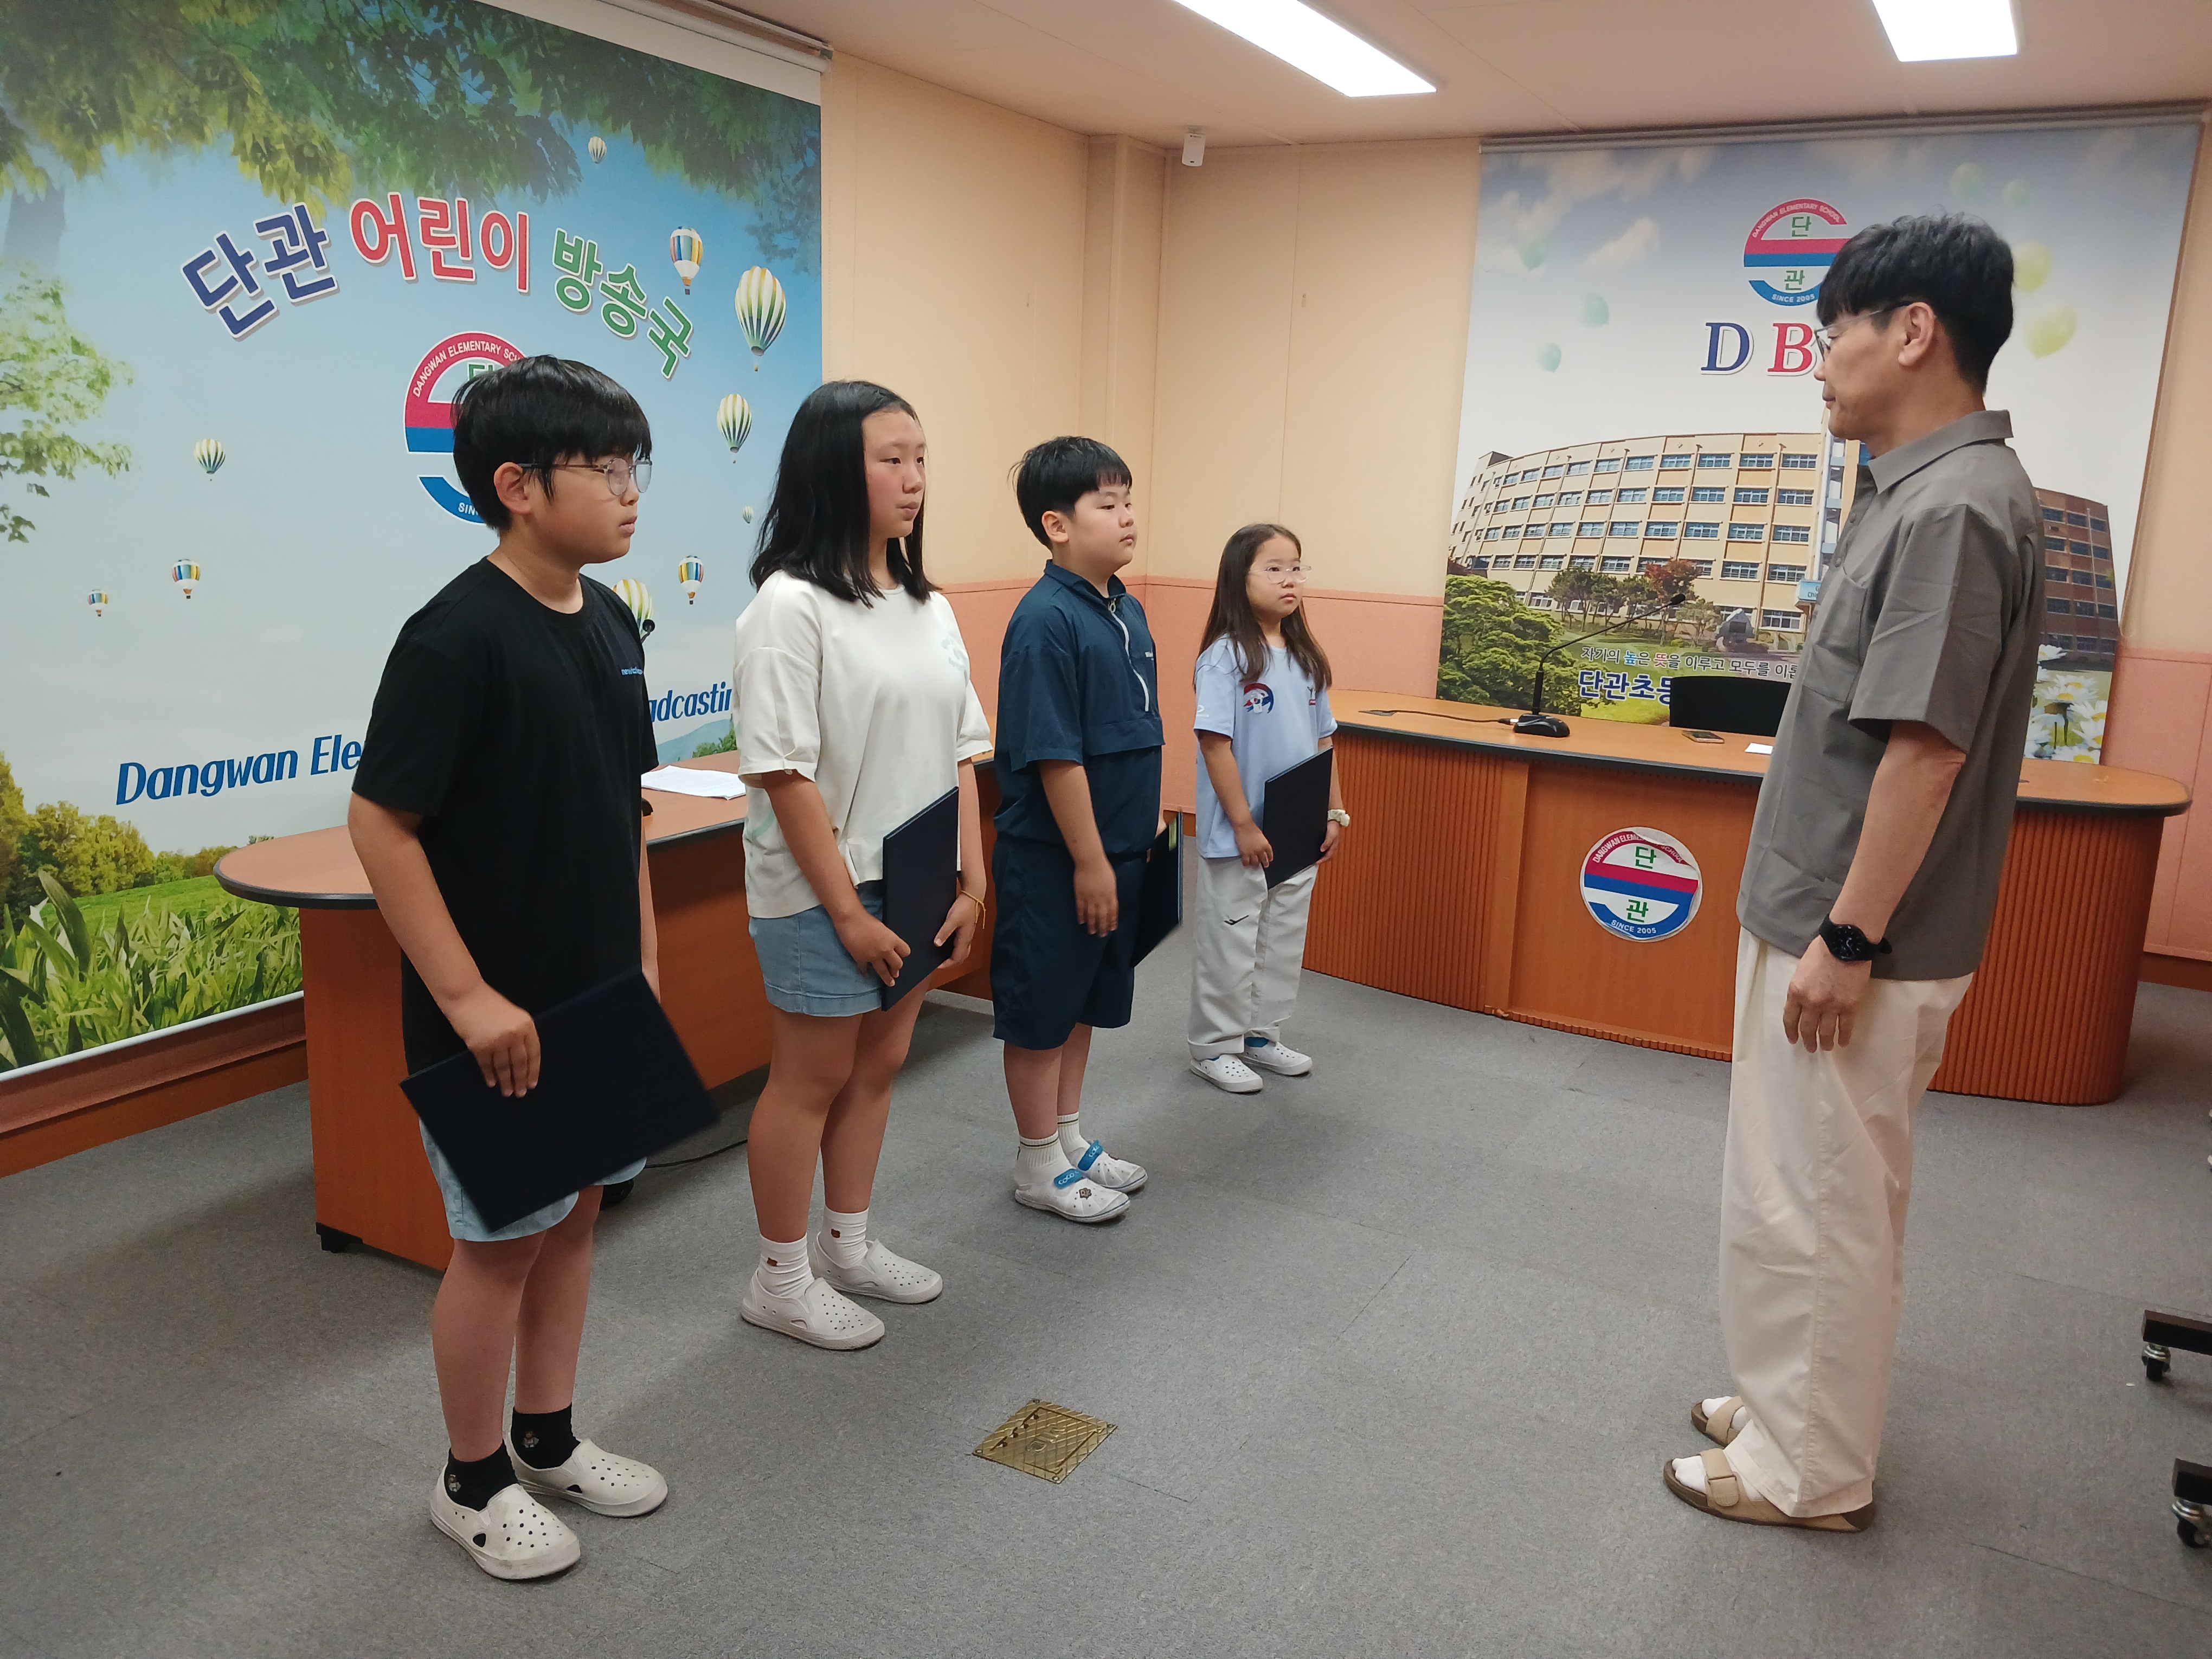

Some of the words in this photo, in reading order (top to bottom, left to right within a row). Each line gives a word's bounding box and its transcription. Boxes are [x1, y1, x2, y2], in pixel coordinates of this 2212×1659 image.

[1752, 211, 1779, 238] DANGWAN
[1779, 202, 1818, 215] ELEMENTARY
[1819, 205, 1841, 223] SCHOOL
[1791, 215, 1812, 237] 단
[181, 202, 338, 338] 단관
[350, 192, 530, 293] 어린이
[552, 228, 693, 379] 방송국
[1784, 269, 1805, 291] 관
[1771, 293, 1794, 303] SINCE
[1796, 293, 1815, 303] 2005
[413, 350, 447, 398] DANGWAN
[447, 340, 502, 358] ELEMENTARY
[1581, 647, 1620, 664] 자기의
[1624, 650, 1650, 666] 높은
[1654, 652, 1681, 669] 뜻을
[1685, 656, 1725, 671] 이루고
[1728, 660, 1770, 677] 모두를
[115, 750, 298, 806] Dangwan
[1592, 837, 1621, 863] DANGWAN
[1635, 846, 1657, 869] 단
[1626, 899, 1649, 923] 관
[1610, 919, 1635, 933] SINCE
